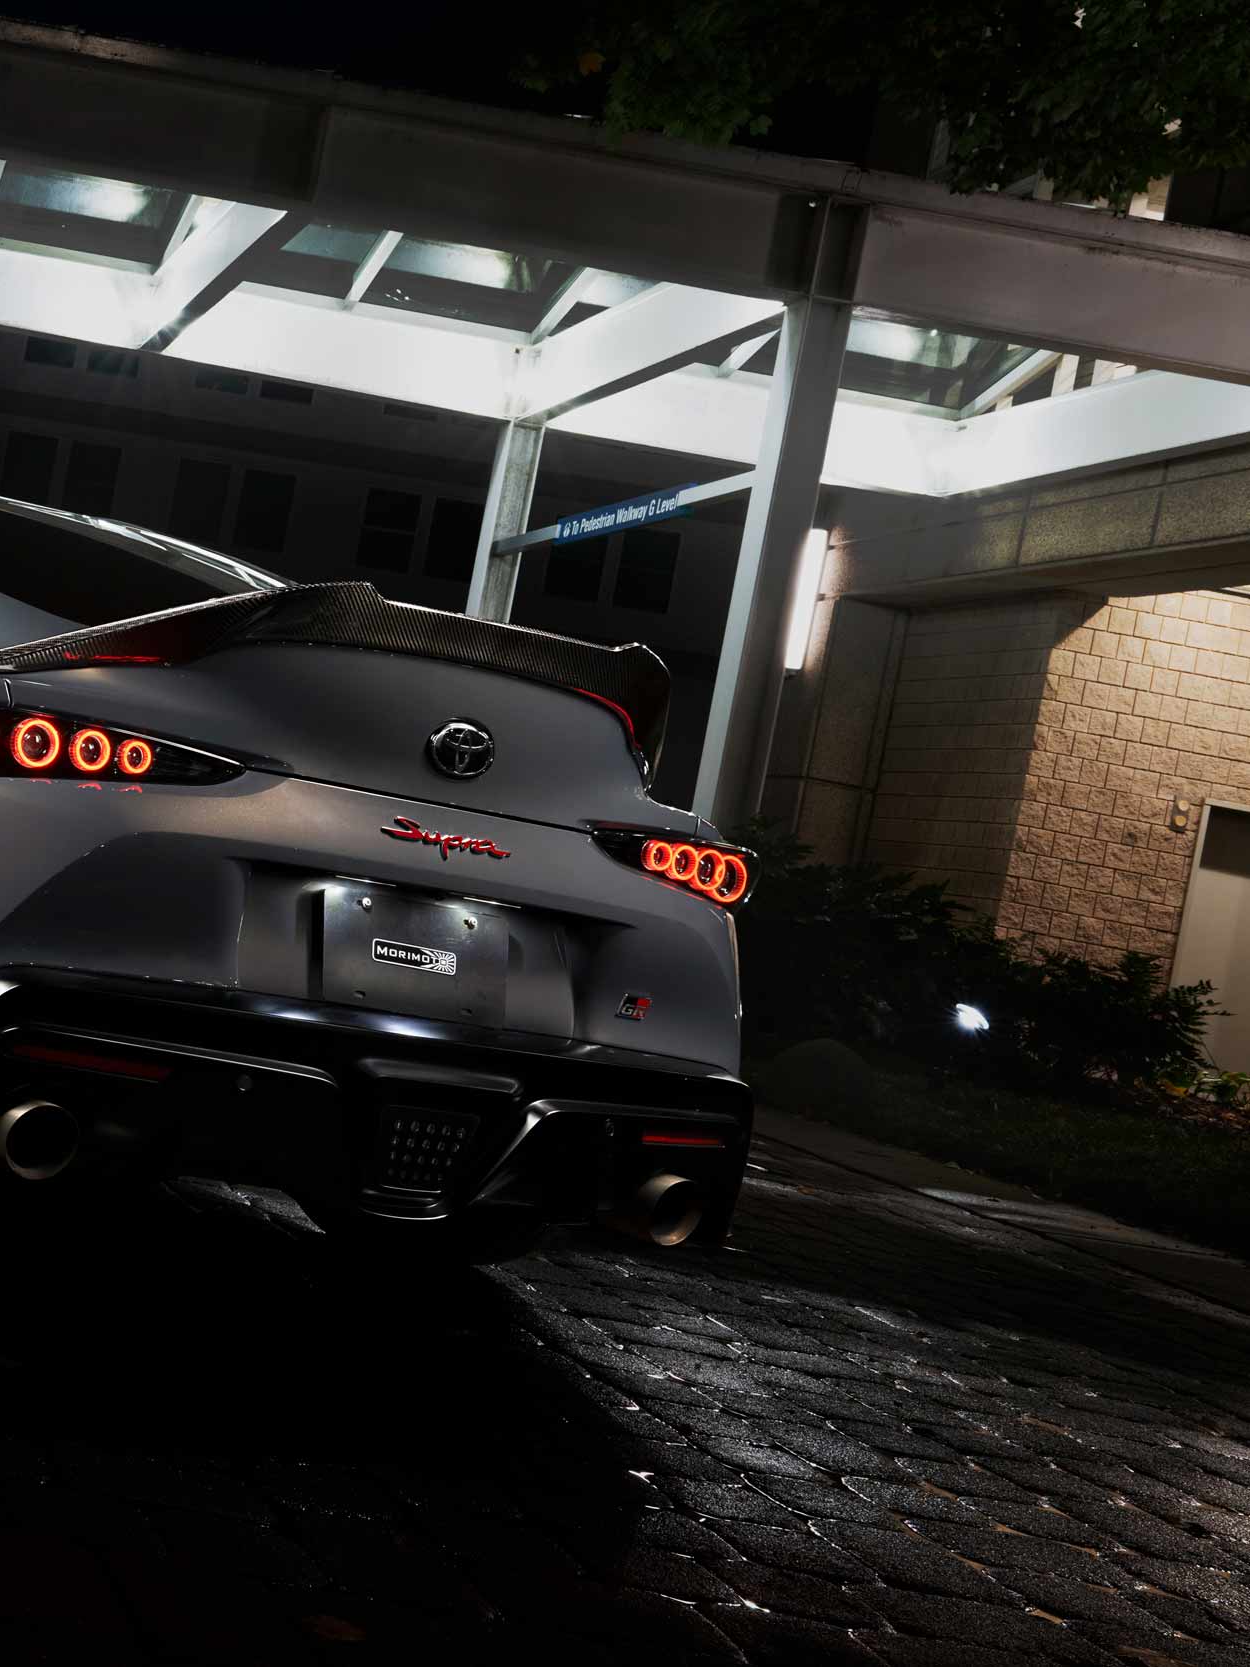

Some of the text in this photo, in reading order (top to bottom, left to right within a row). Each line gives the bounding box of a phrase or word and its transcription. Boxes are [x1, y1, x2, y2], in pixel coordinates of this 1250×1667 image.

[571, 493, 679, 536] To Pedestrian Walkway G Level
[380, 815, 511, 861] Supra
